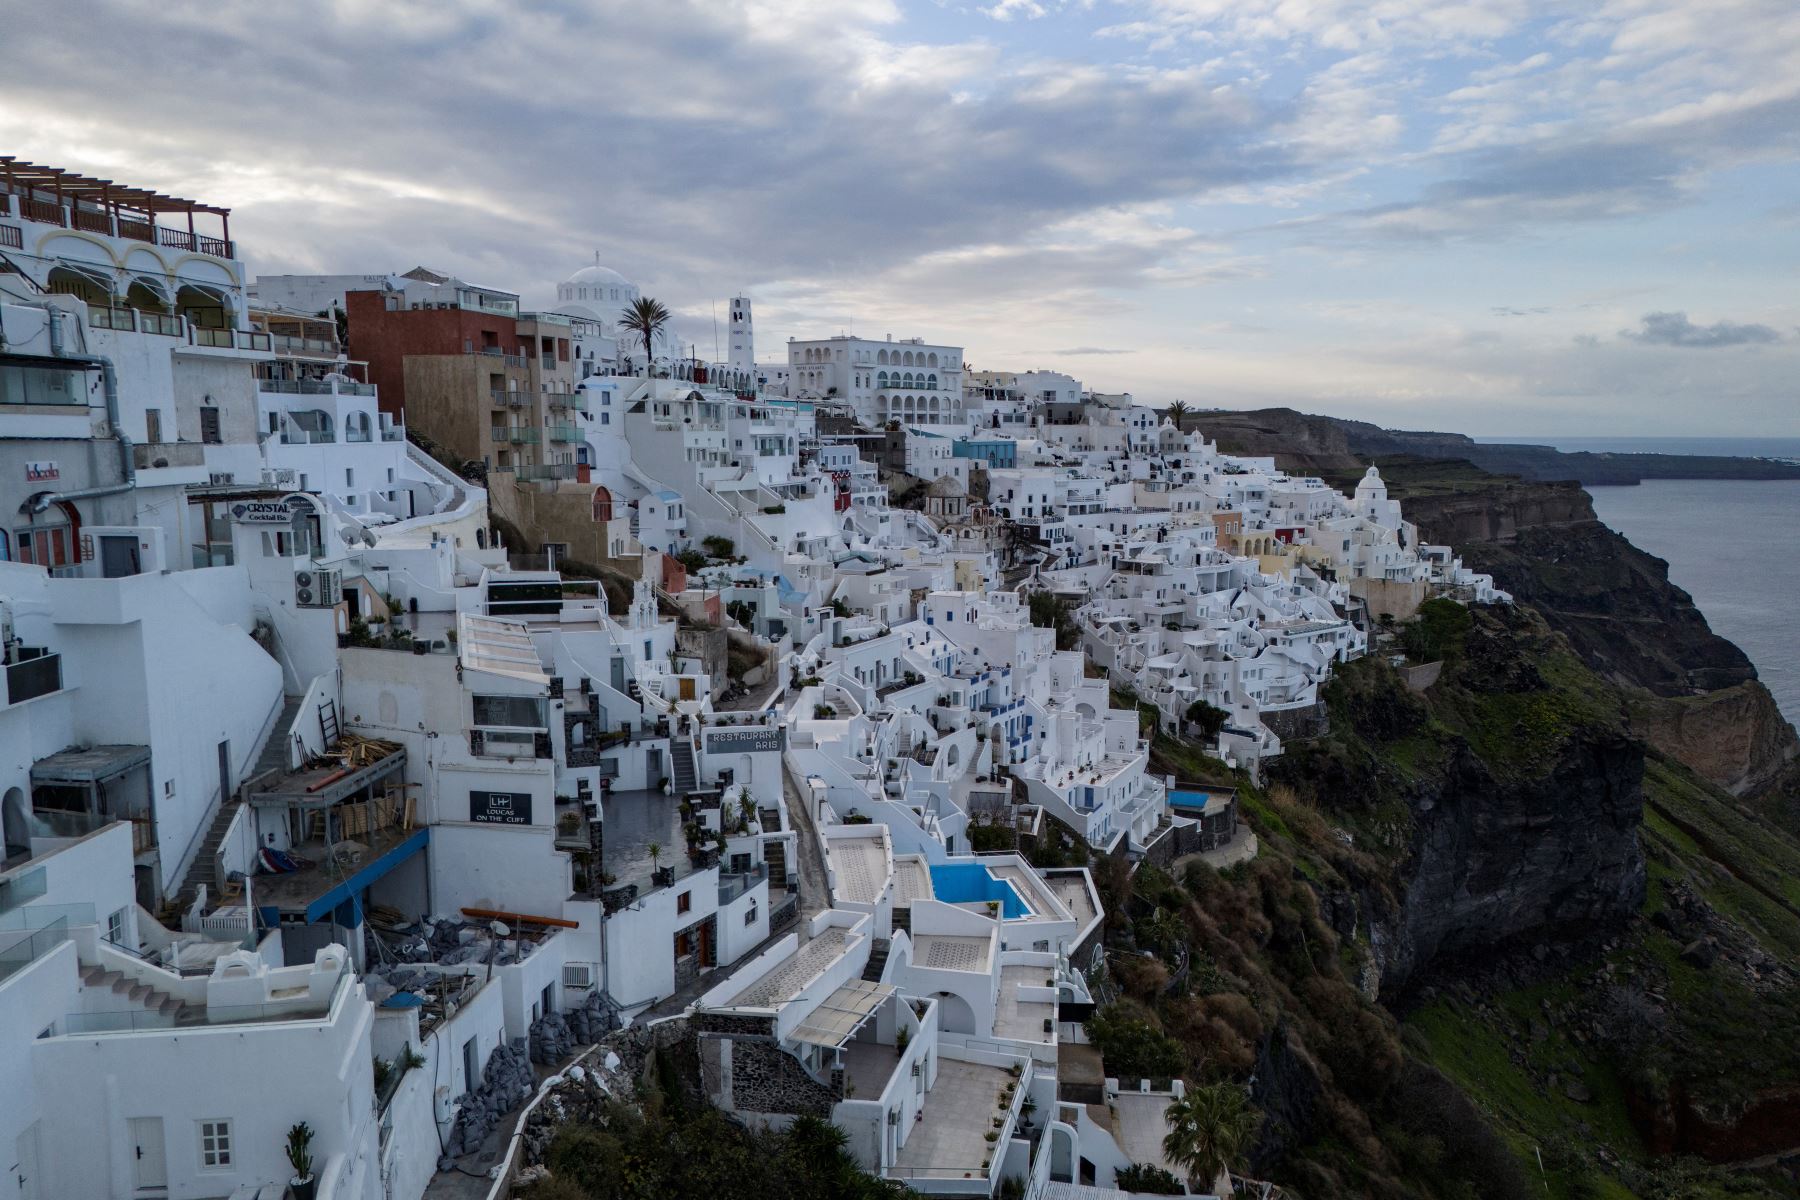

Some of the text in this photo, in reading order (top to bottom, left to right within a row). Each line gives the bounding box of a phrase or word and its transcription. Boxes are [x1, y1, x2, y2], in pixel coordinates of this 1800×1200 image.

[247, 503, 290, 513] CRYSTAL
[713, 731, 777, 742] RESTAURANT
[755, 741, 778, 749] ARIS
